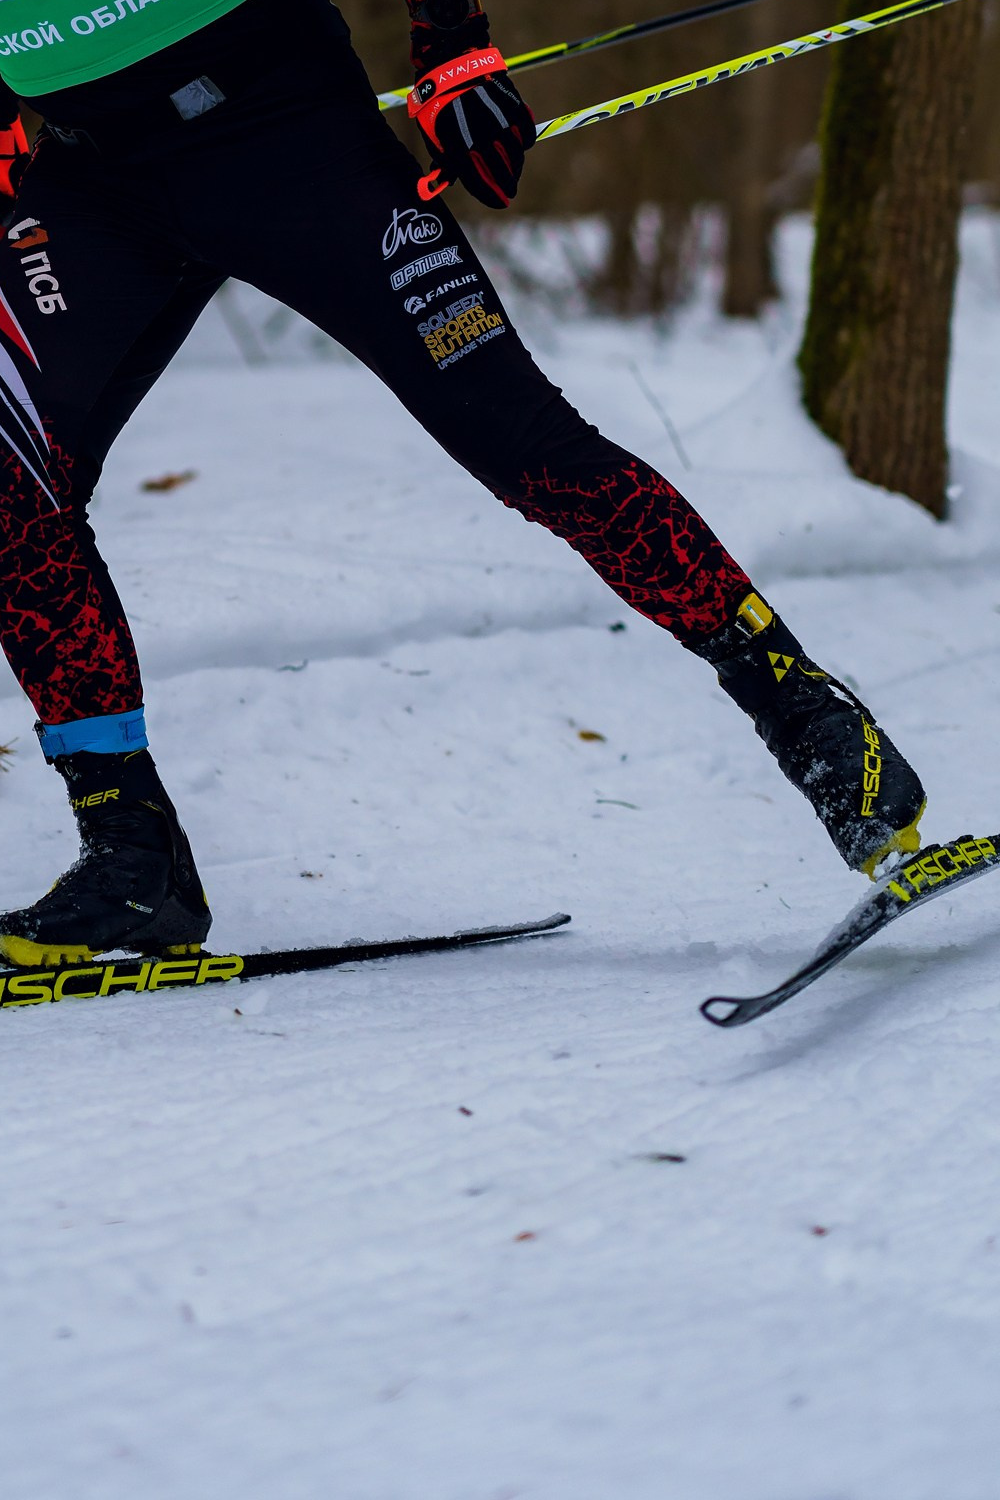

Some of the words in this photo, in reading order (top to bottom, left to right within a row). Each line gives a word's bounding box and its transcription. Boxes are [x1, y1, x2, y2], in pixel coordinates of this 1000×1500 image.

[20, 251, 68, 315] ПСБ
[390, 245, 463, 290] OPTIWAX
[425, 274, 478, 303] FANLIFE
[417, 291, 484, 338] SQUEEZY
[424, 305, 486, 349] SPORTS
[430, 312, 503, 362] NUTRITION
[437, 342, 477, 370] UPGRADE
[903, 837, 997, 894] FISCHER
